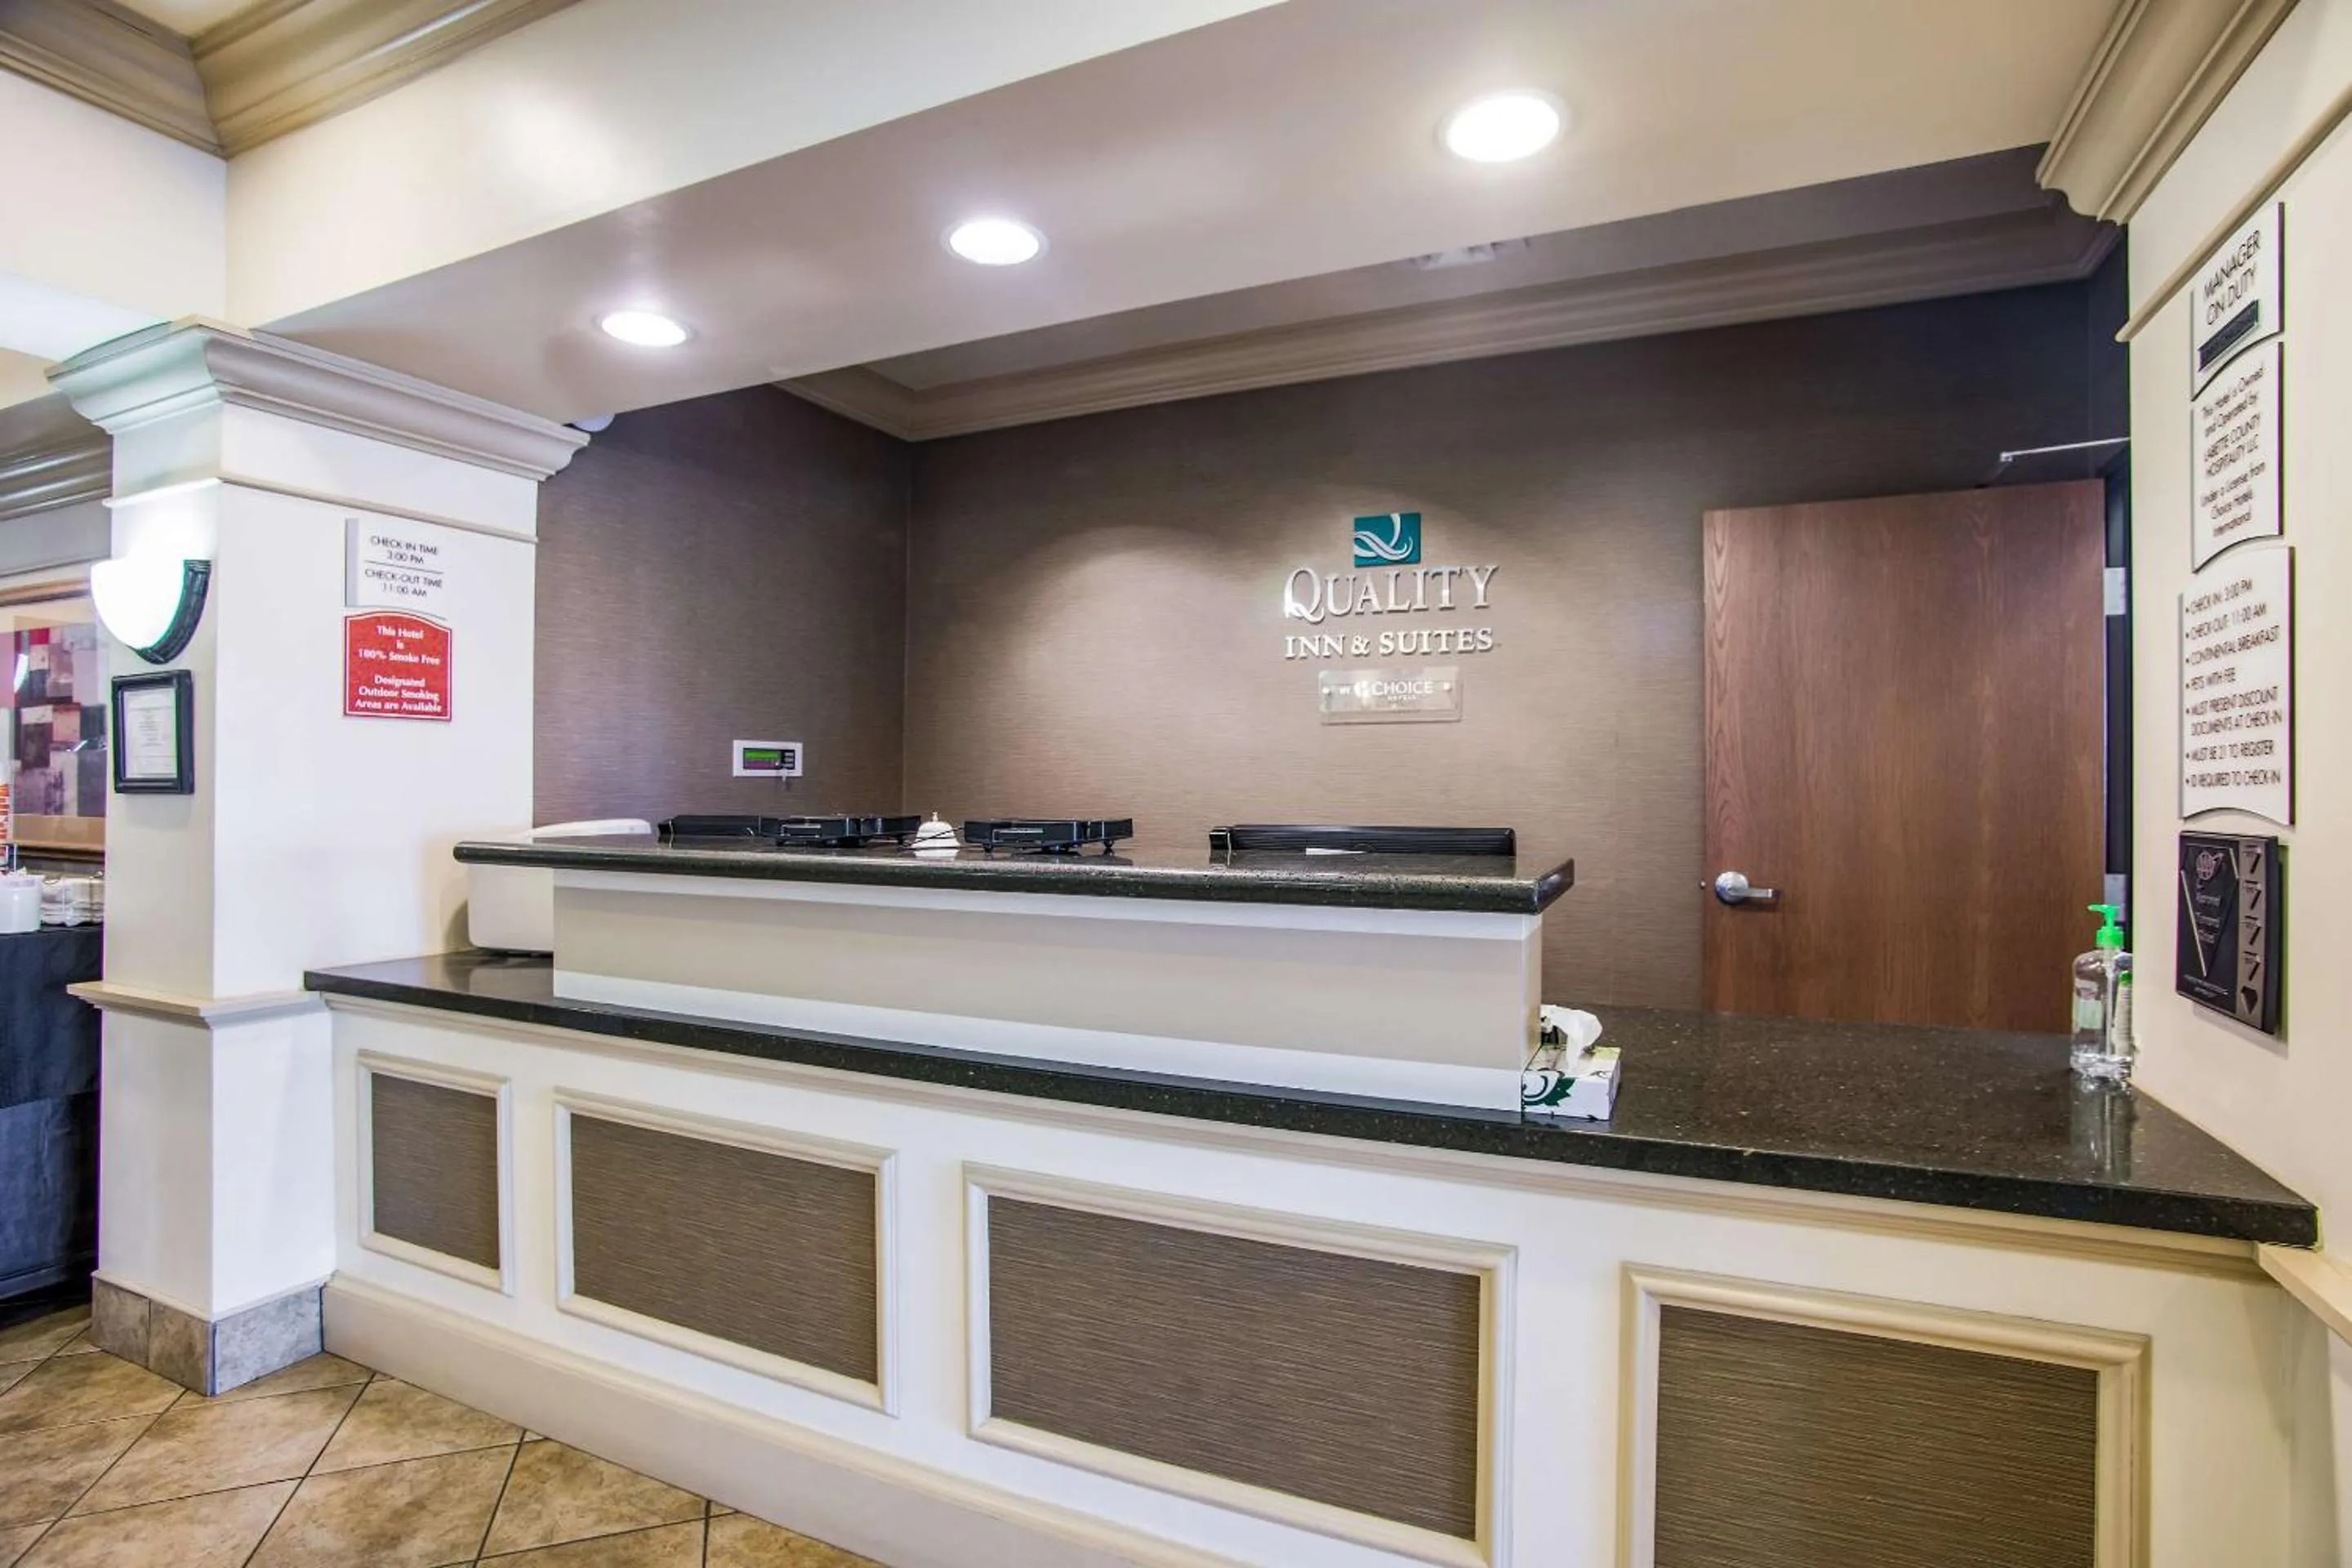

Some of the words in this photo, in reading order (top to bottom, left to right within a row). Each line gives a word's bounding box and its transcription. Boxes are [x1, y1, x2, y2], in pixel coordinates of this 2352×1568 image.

[2204, 229, 2261, 299] MANAGER
[2207, 292, 2225, 325] ON
[2228, 262, 2257, 308] DUTY
[420, 544, 438, 555] TIME
[411, 555, 424, 564] PM
[424, 577, 443, 588] TIME
[412, 587, 427, 597] AM
[1283, 564, 1499, 625] QUALITY
[376, 625, 396, 637] This
[398, 628, 424, 639] Hotel
[1285, 634, 1346, 660] INN
[1350, 633, 1371, 657] &
[1379, 627, 1494, 657] SUITES
[359, 648, 387, 660] 100%
[389, 652, 420, 664] Smoke
[421, 654, 440, 666] Free
[374, 674, 425, 688] Designated
[1372, 680, 1433, 696] CHOICE
[359, 686, 399, 697] Outdoor
[401, 688, 439, 703] Smoking
[354, 699, 382, 710] Areas
[384, 702, 399, 710] are
[401, 702, 442, 713] Available
